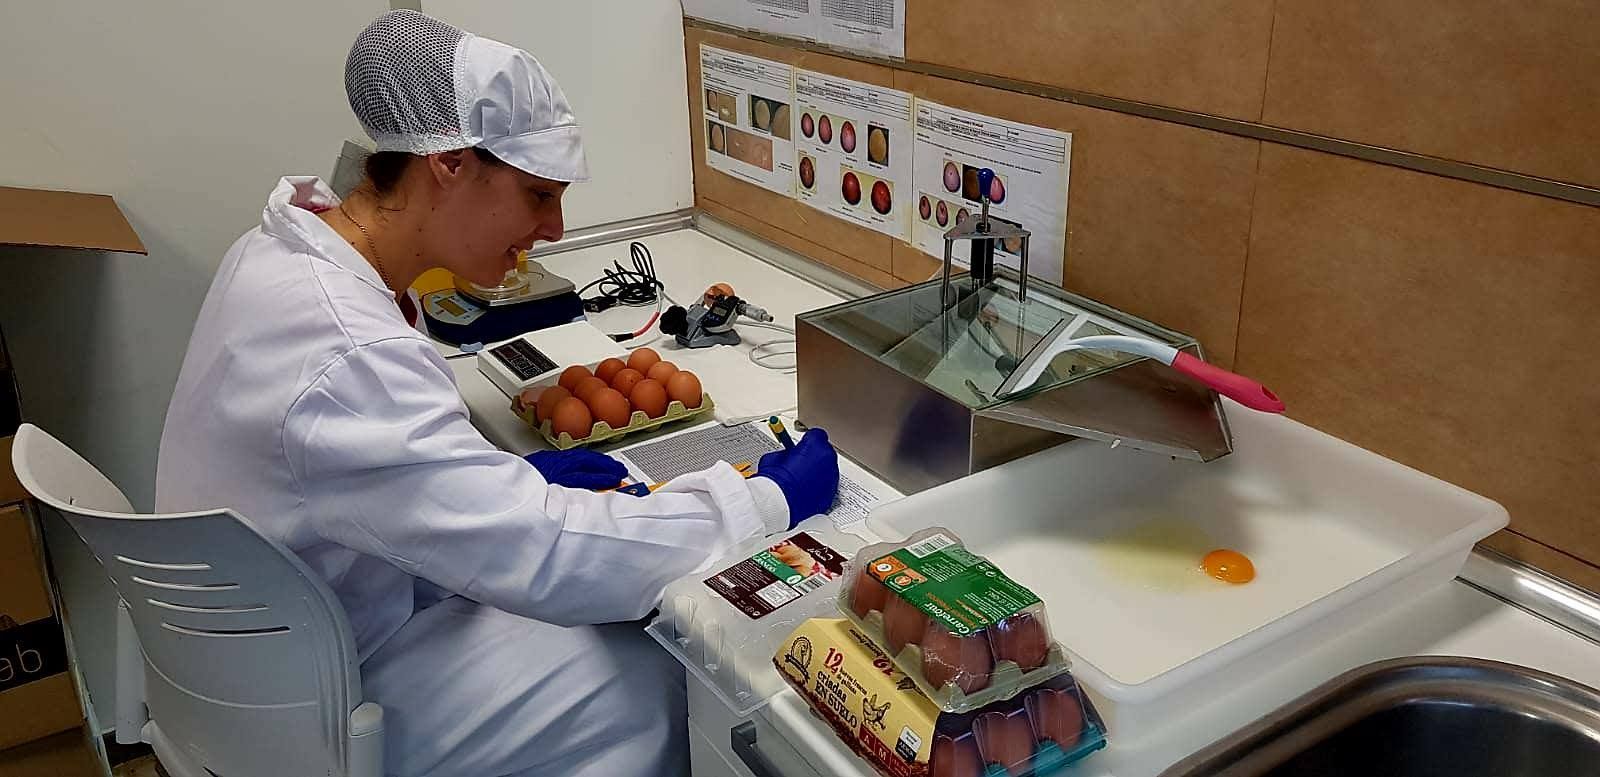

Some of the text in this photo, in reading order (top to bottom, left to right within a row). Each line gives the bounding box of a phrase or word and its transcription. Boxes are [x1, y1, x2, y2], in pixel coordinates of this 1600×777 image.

[924, 602, 970, 633] Carrefour
[824, 647, 843, 674] 12
[873, 658, 894, 676] 12
[817, 670, 847, 703] criadas
[815, 680, 857, 728] EN SUELO
[879, 747, 886, 760] M
